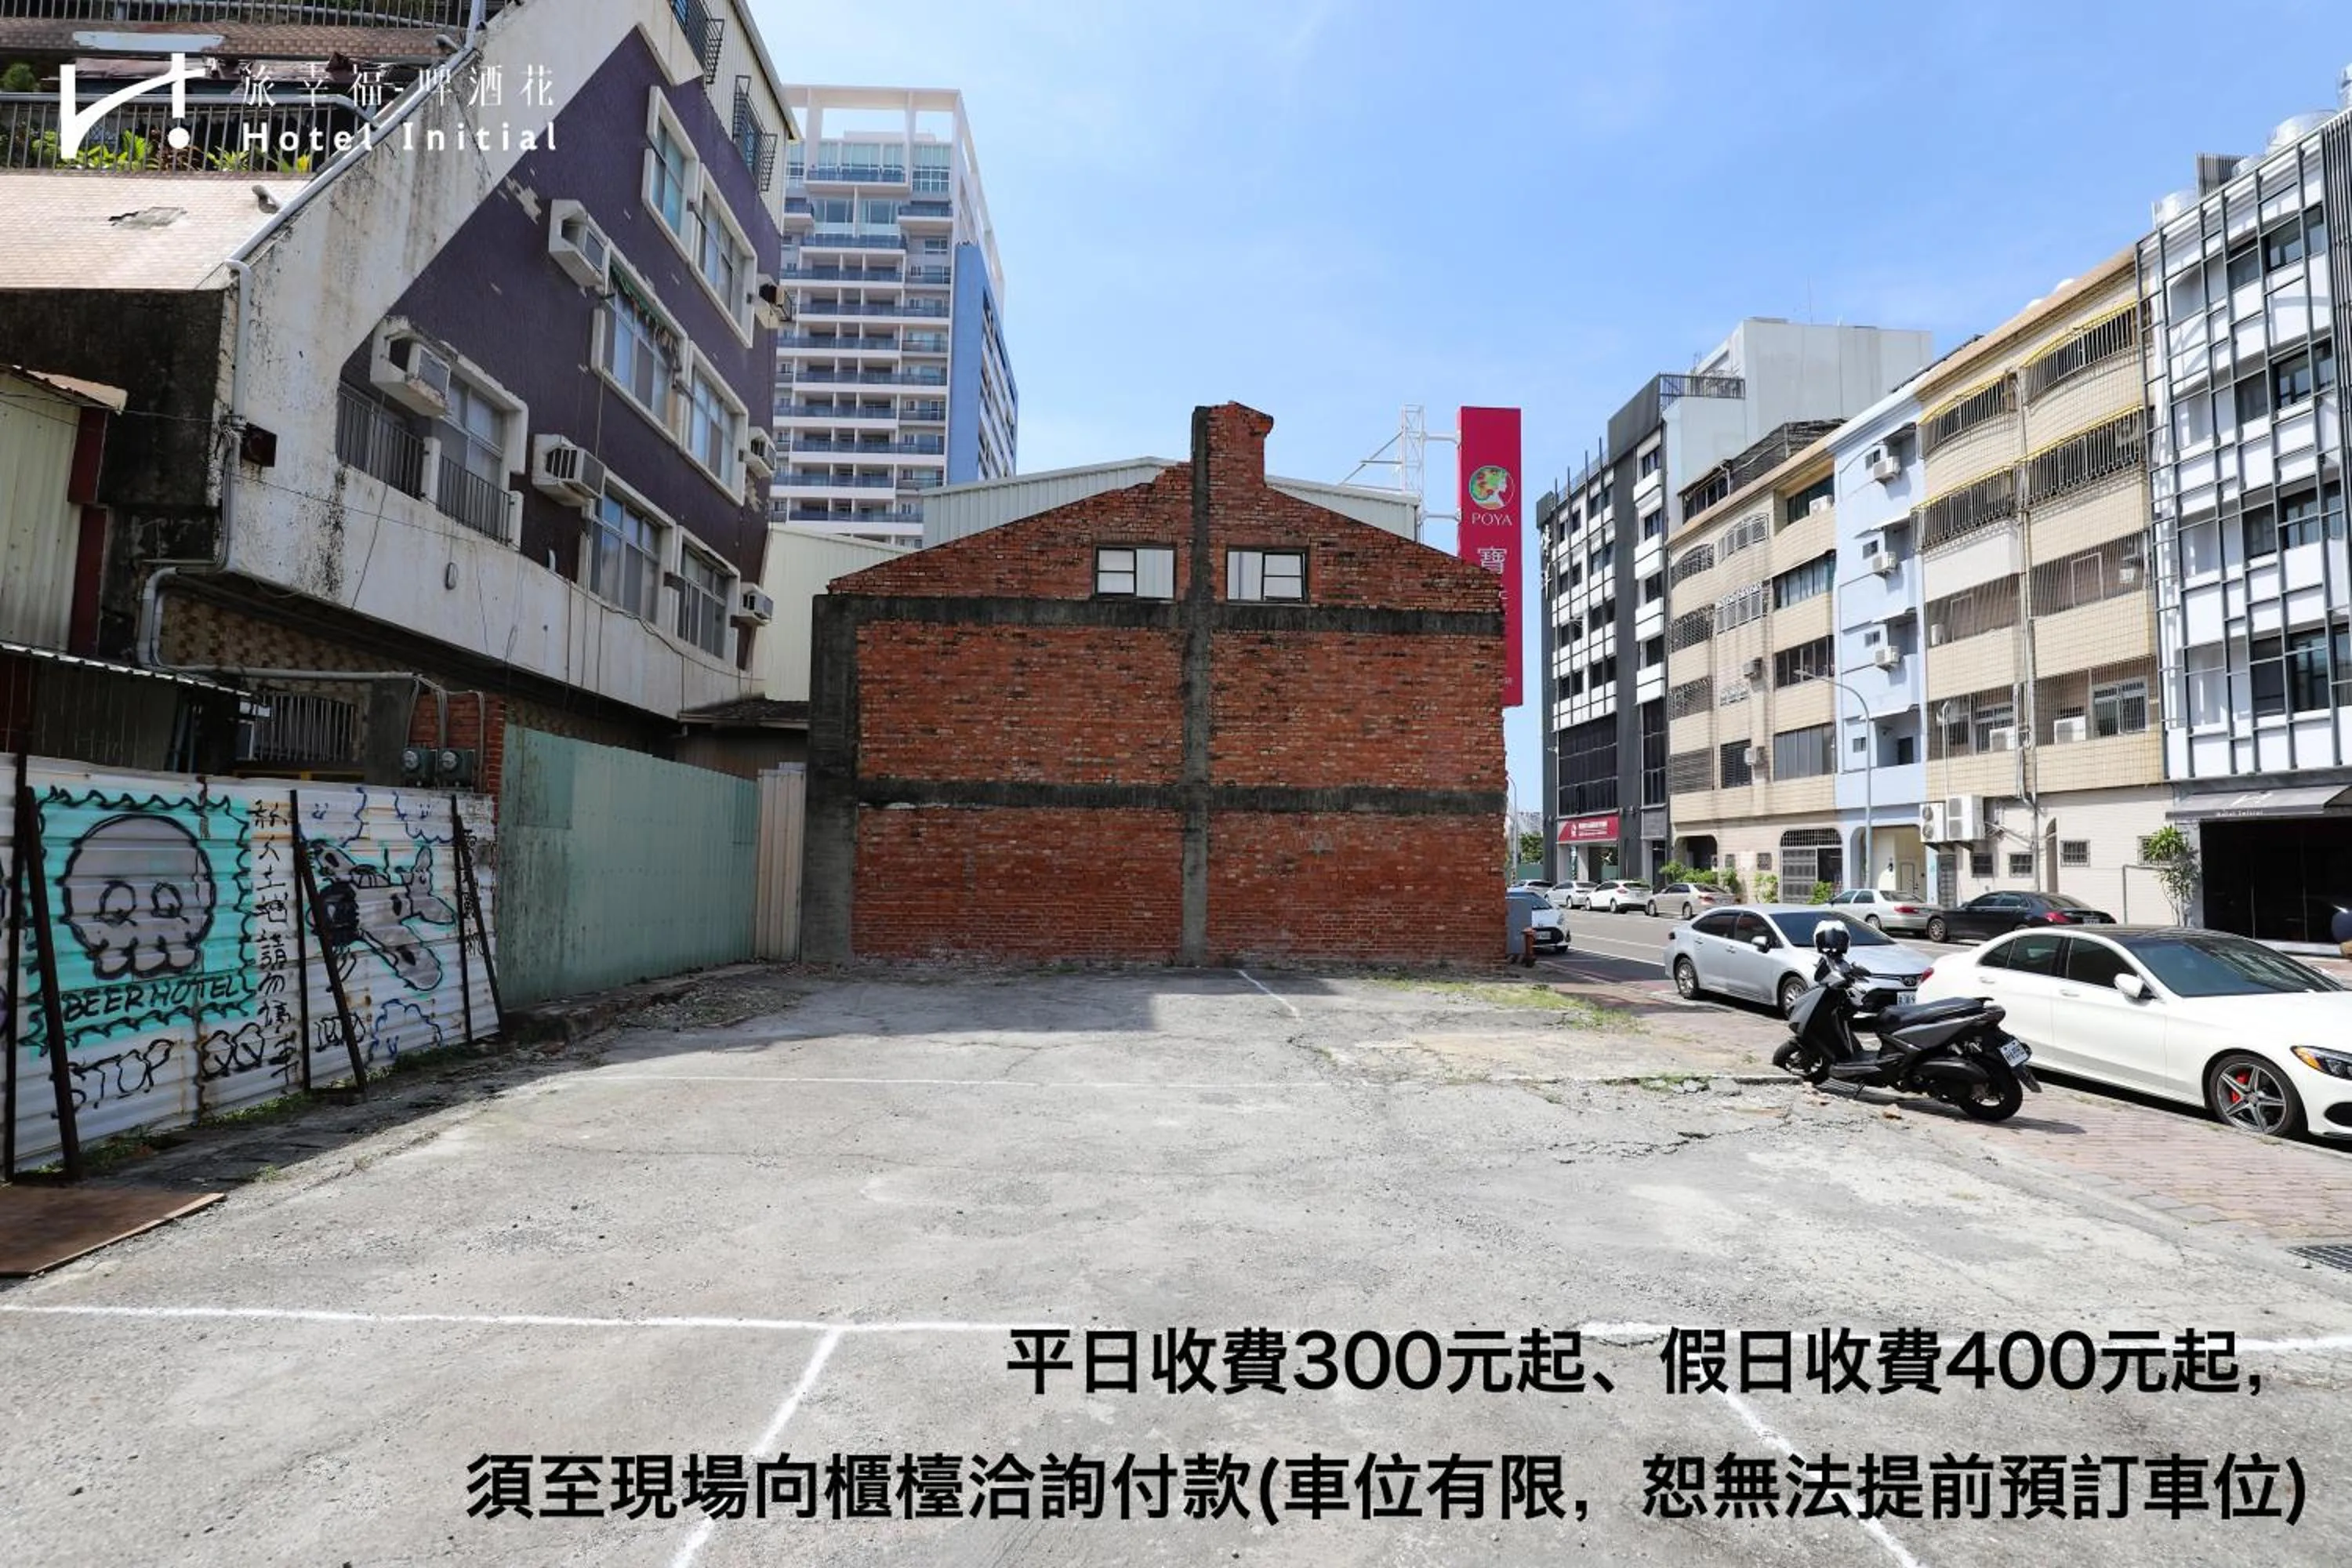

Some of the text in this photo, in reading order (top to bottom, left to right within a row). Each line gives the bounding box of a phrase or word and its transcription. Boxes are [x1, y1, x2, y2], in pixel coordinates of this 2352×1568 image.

[1472, 513, 1513, 526] POYA
[62, 974, 240, 1022] BEER HOTEL
